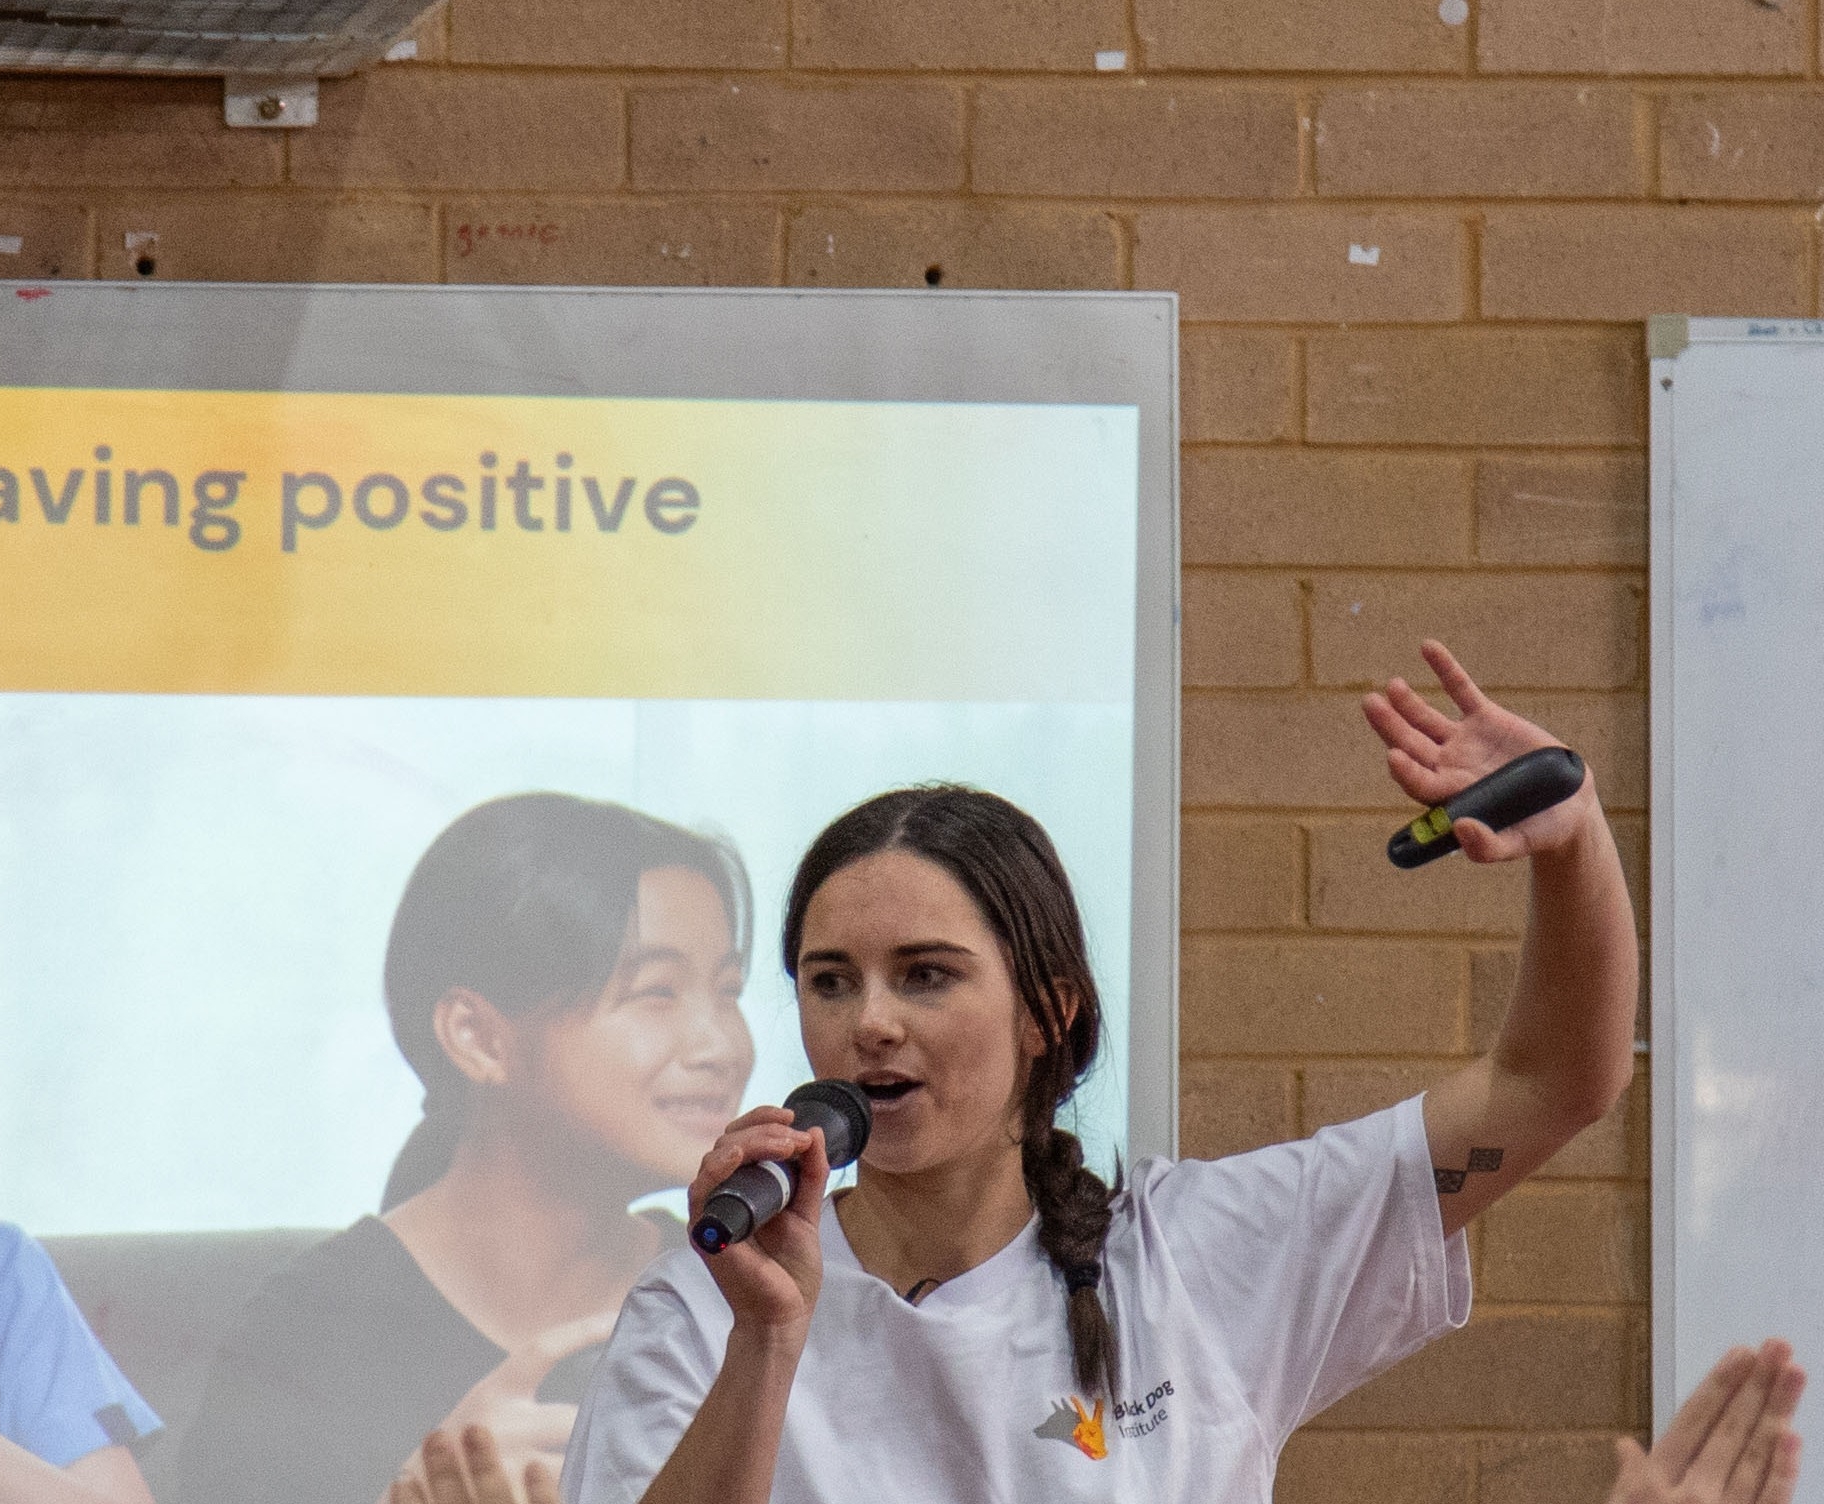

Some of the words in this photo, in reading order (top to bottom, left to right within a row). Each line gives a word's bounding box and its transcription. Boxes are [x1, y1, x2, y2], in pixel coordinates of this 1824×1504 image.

[279, 450, 702, 555] positive
[1113, 1399, 1146, 1421] Blck
[1145, 1380, 1175, 1410] Dog
